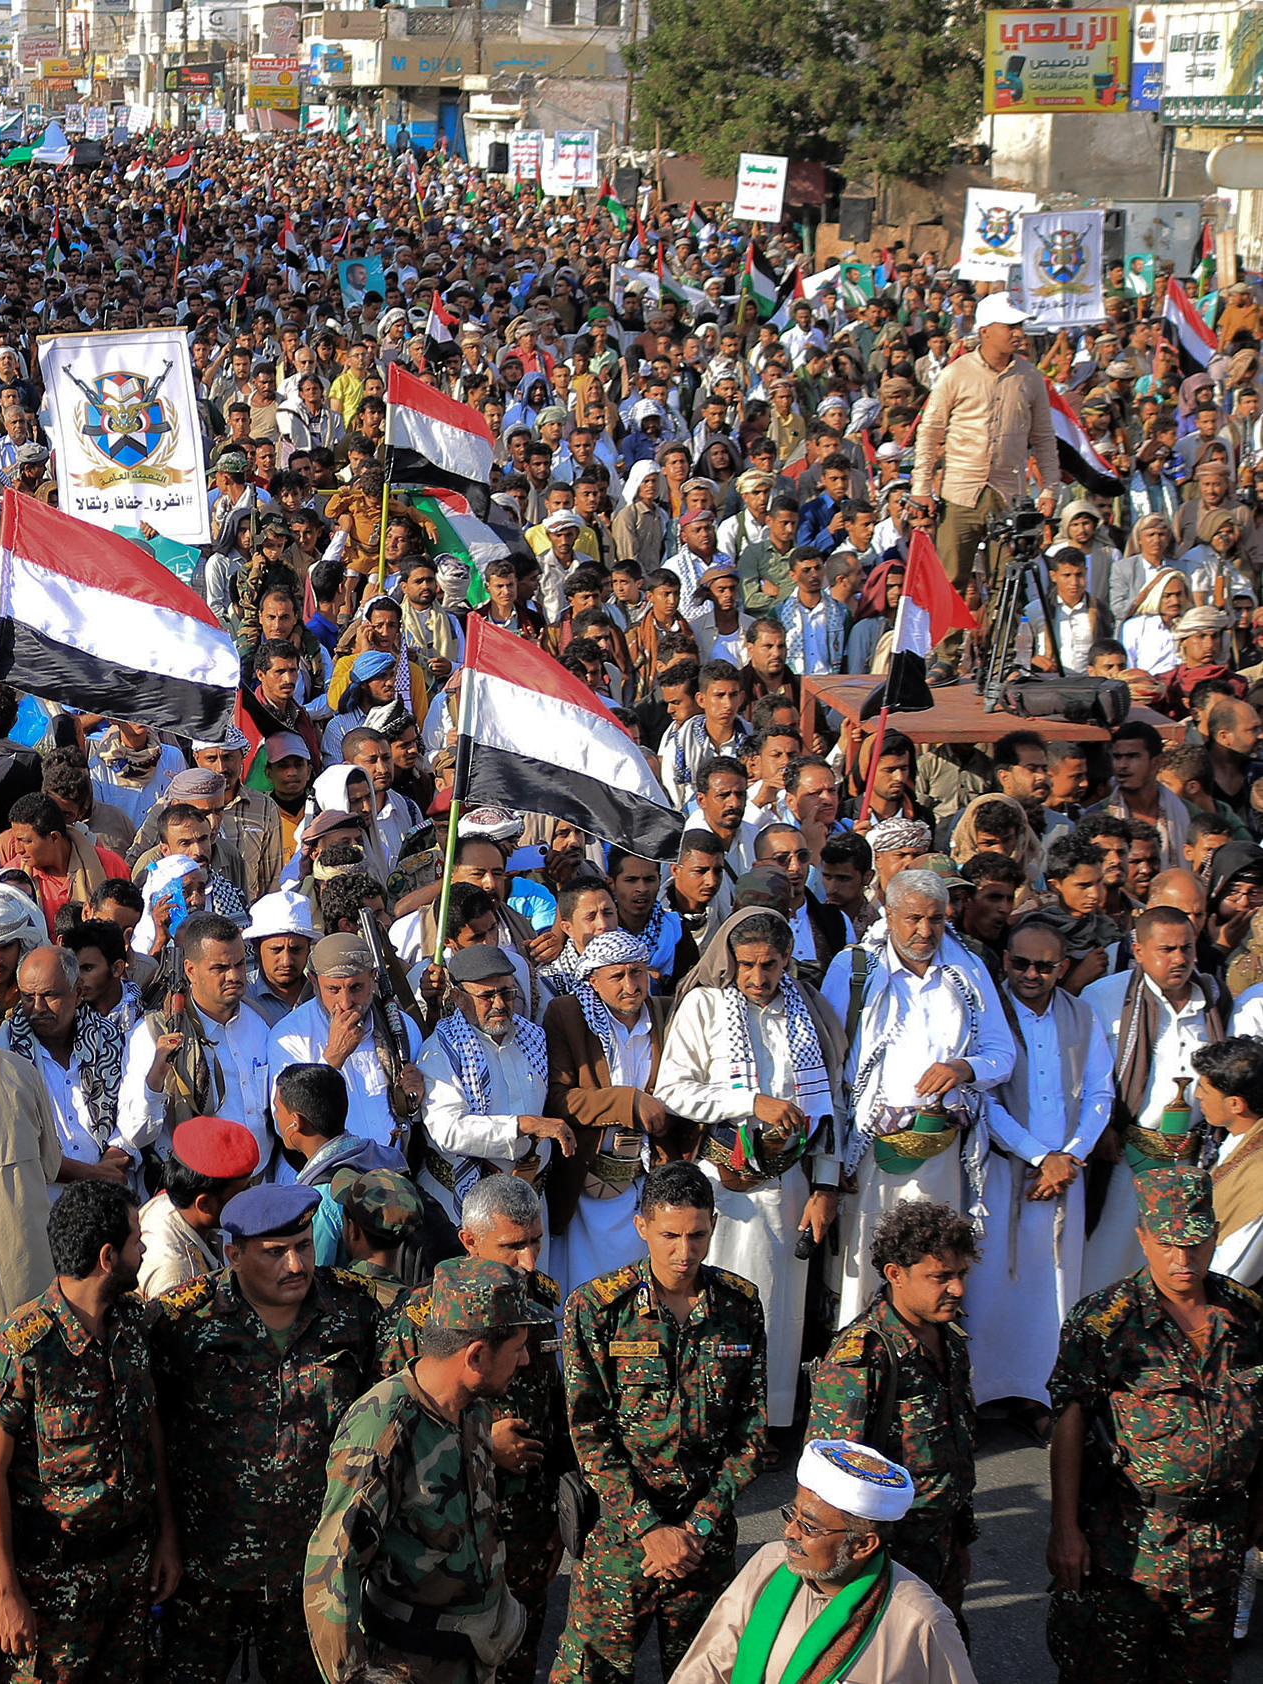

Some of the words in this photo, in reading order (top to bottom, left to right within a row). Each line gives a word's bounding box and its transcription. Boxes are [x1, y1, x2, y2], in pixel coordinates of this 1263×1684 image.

[1000, 16, 1118, 51] الزيلعي
[98, 471, 131, 487] العامة
[132, 470, 168, 484] التعبئة
